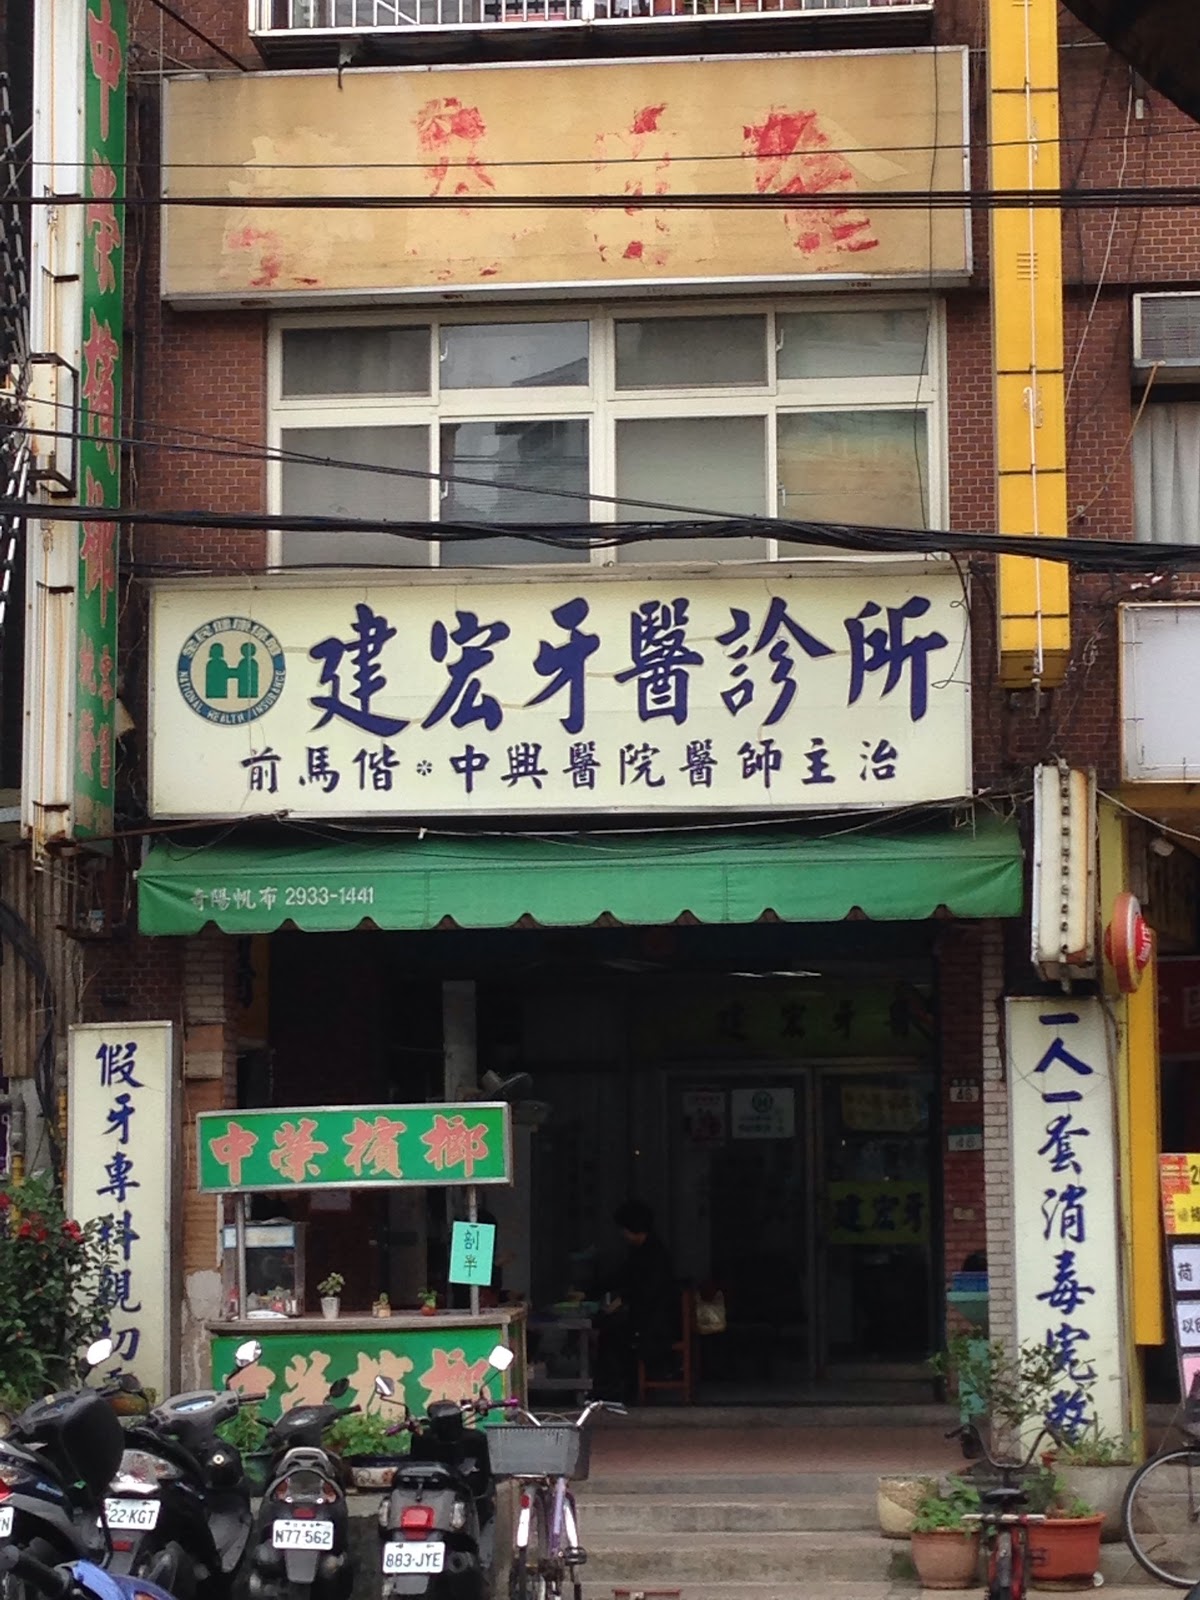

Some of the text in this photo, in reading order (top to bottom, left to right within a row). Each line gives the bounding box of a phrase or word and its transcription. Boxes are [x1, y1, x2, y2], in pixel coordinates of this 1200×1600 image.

[308, 596, 948, 738] 建宏牙醫診所
[178, 670, 203, 714] NATIONAL
[206, 709, 246, 724] HEALTH
[285, 886, 374, 906] 2933-1441
[207, 1114, 489, 1186] 中榮檳榔
[107, 1508, 156, 1525] 22-KGT
